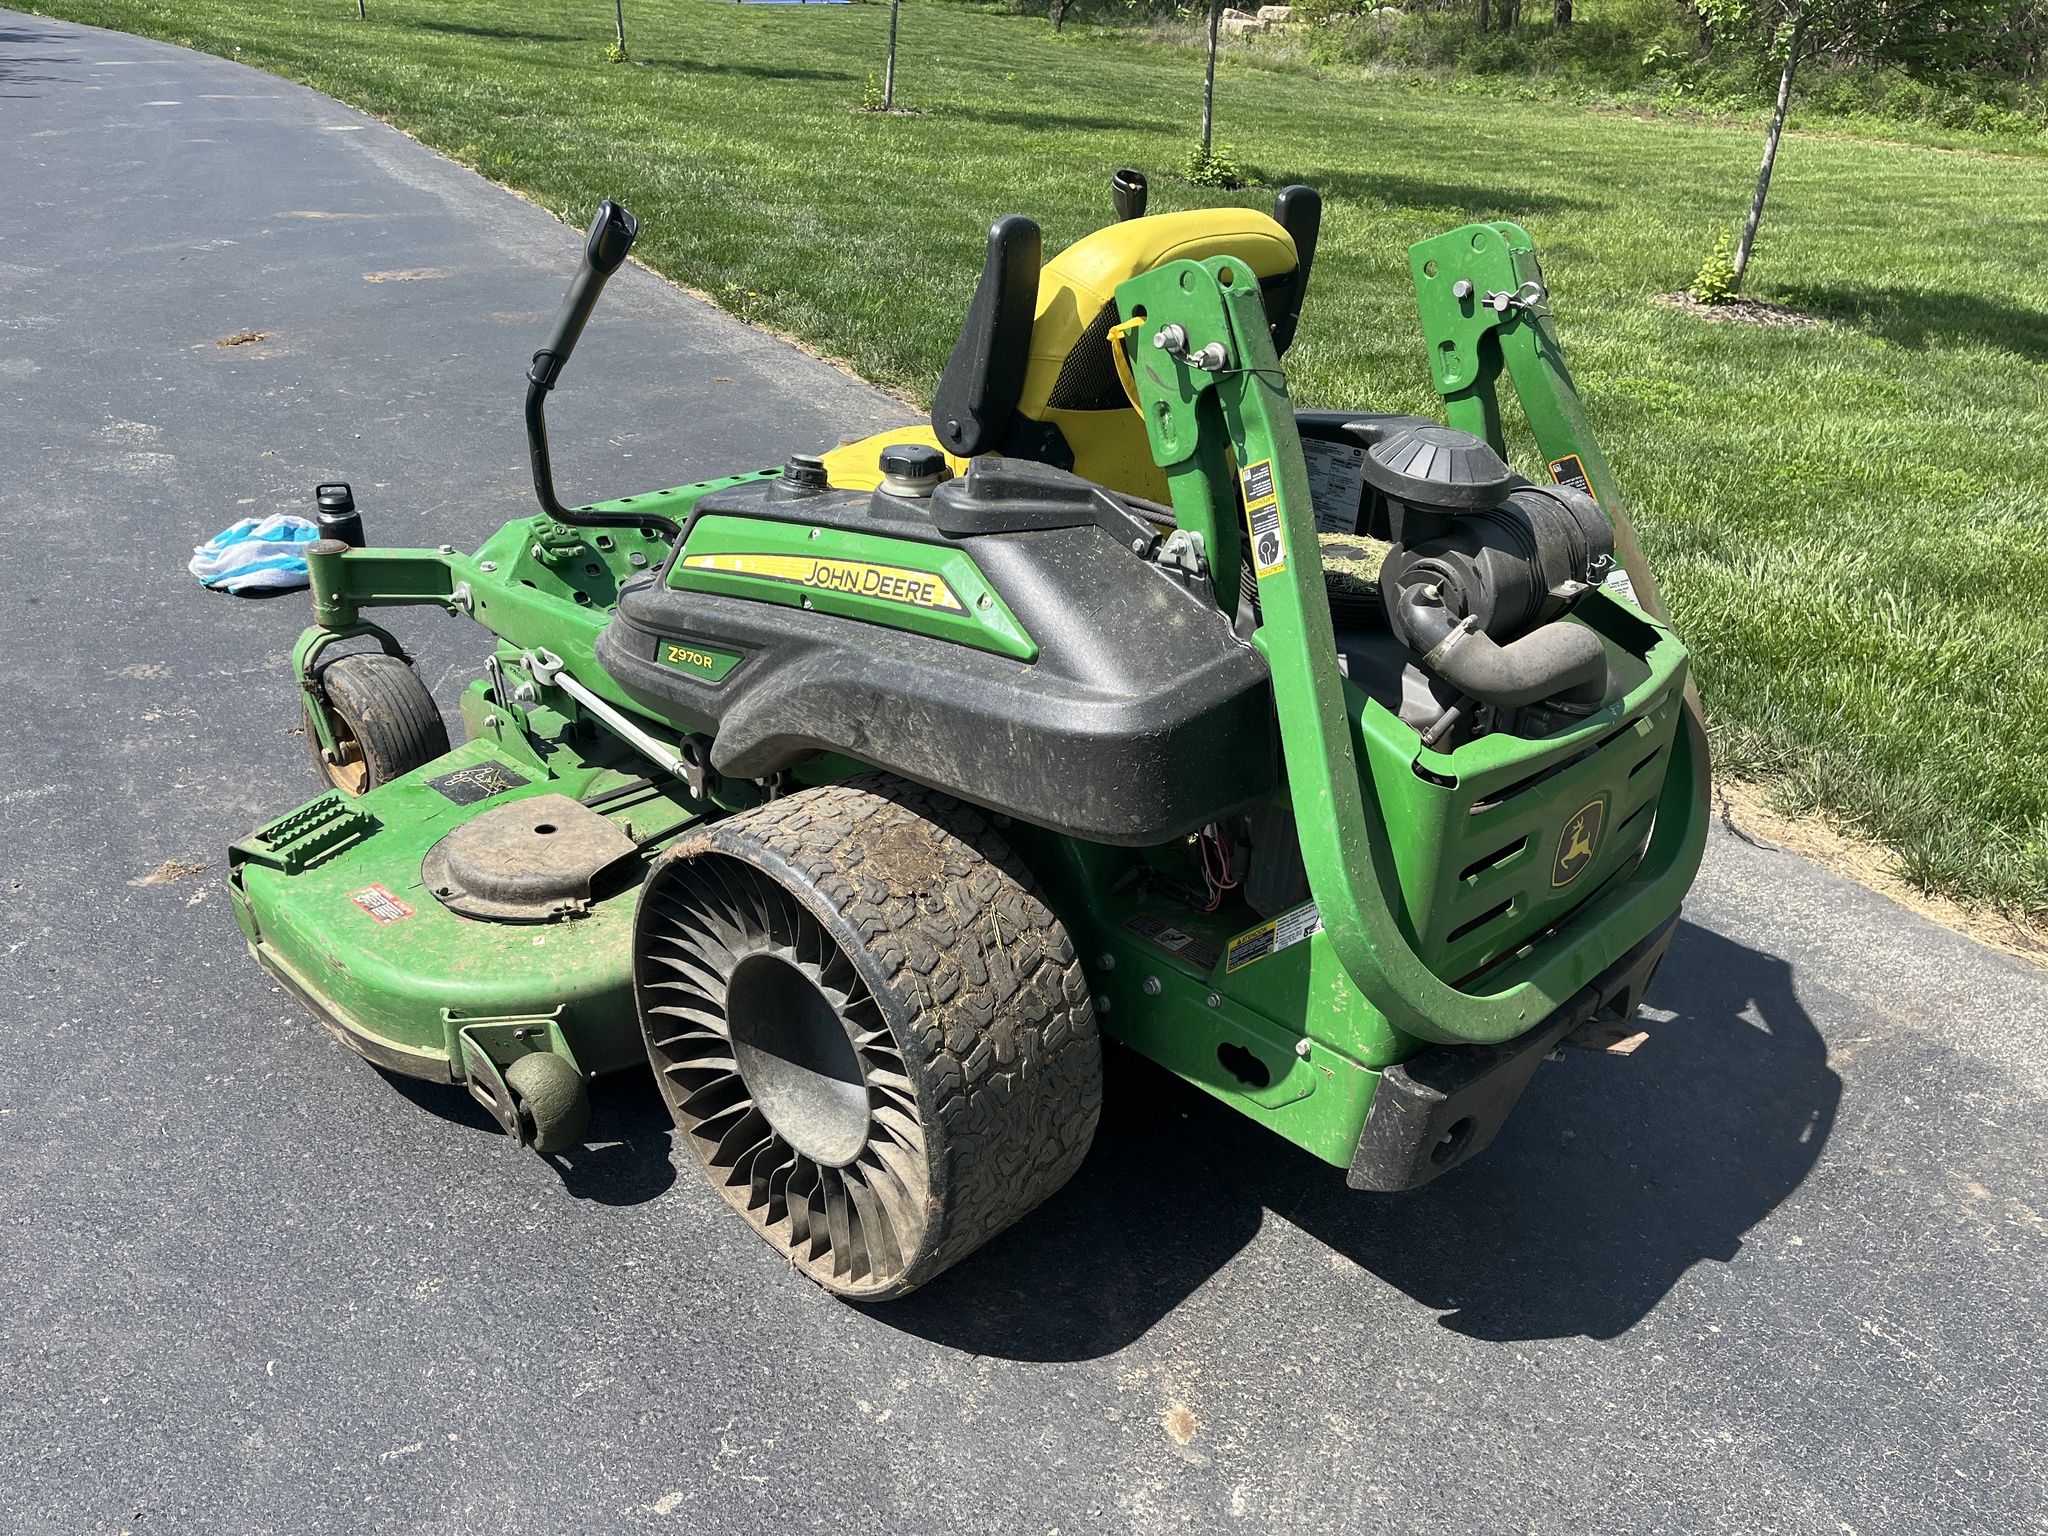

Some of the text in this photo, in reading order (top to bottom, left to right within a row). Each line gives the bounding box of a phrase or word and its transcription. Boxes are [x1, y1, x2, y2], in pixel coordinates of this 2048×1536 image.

[803, 561, 936, 602] JOHN DEERE
[667, 645, 713, 670] Z970R
